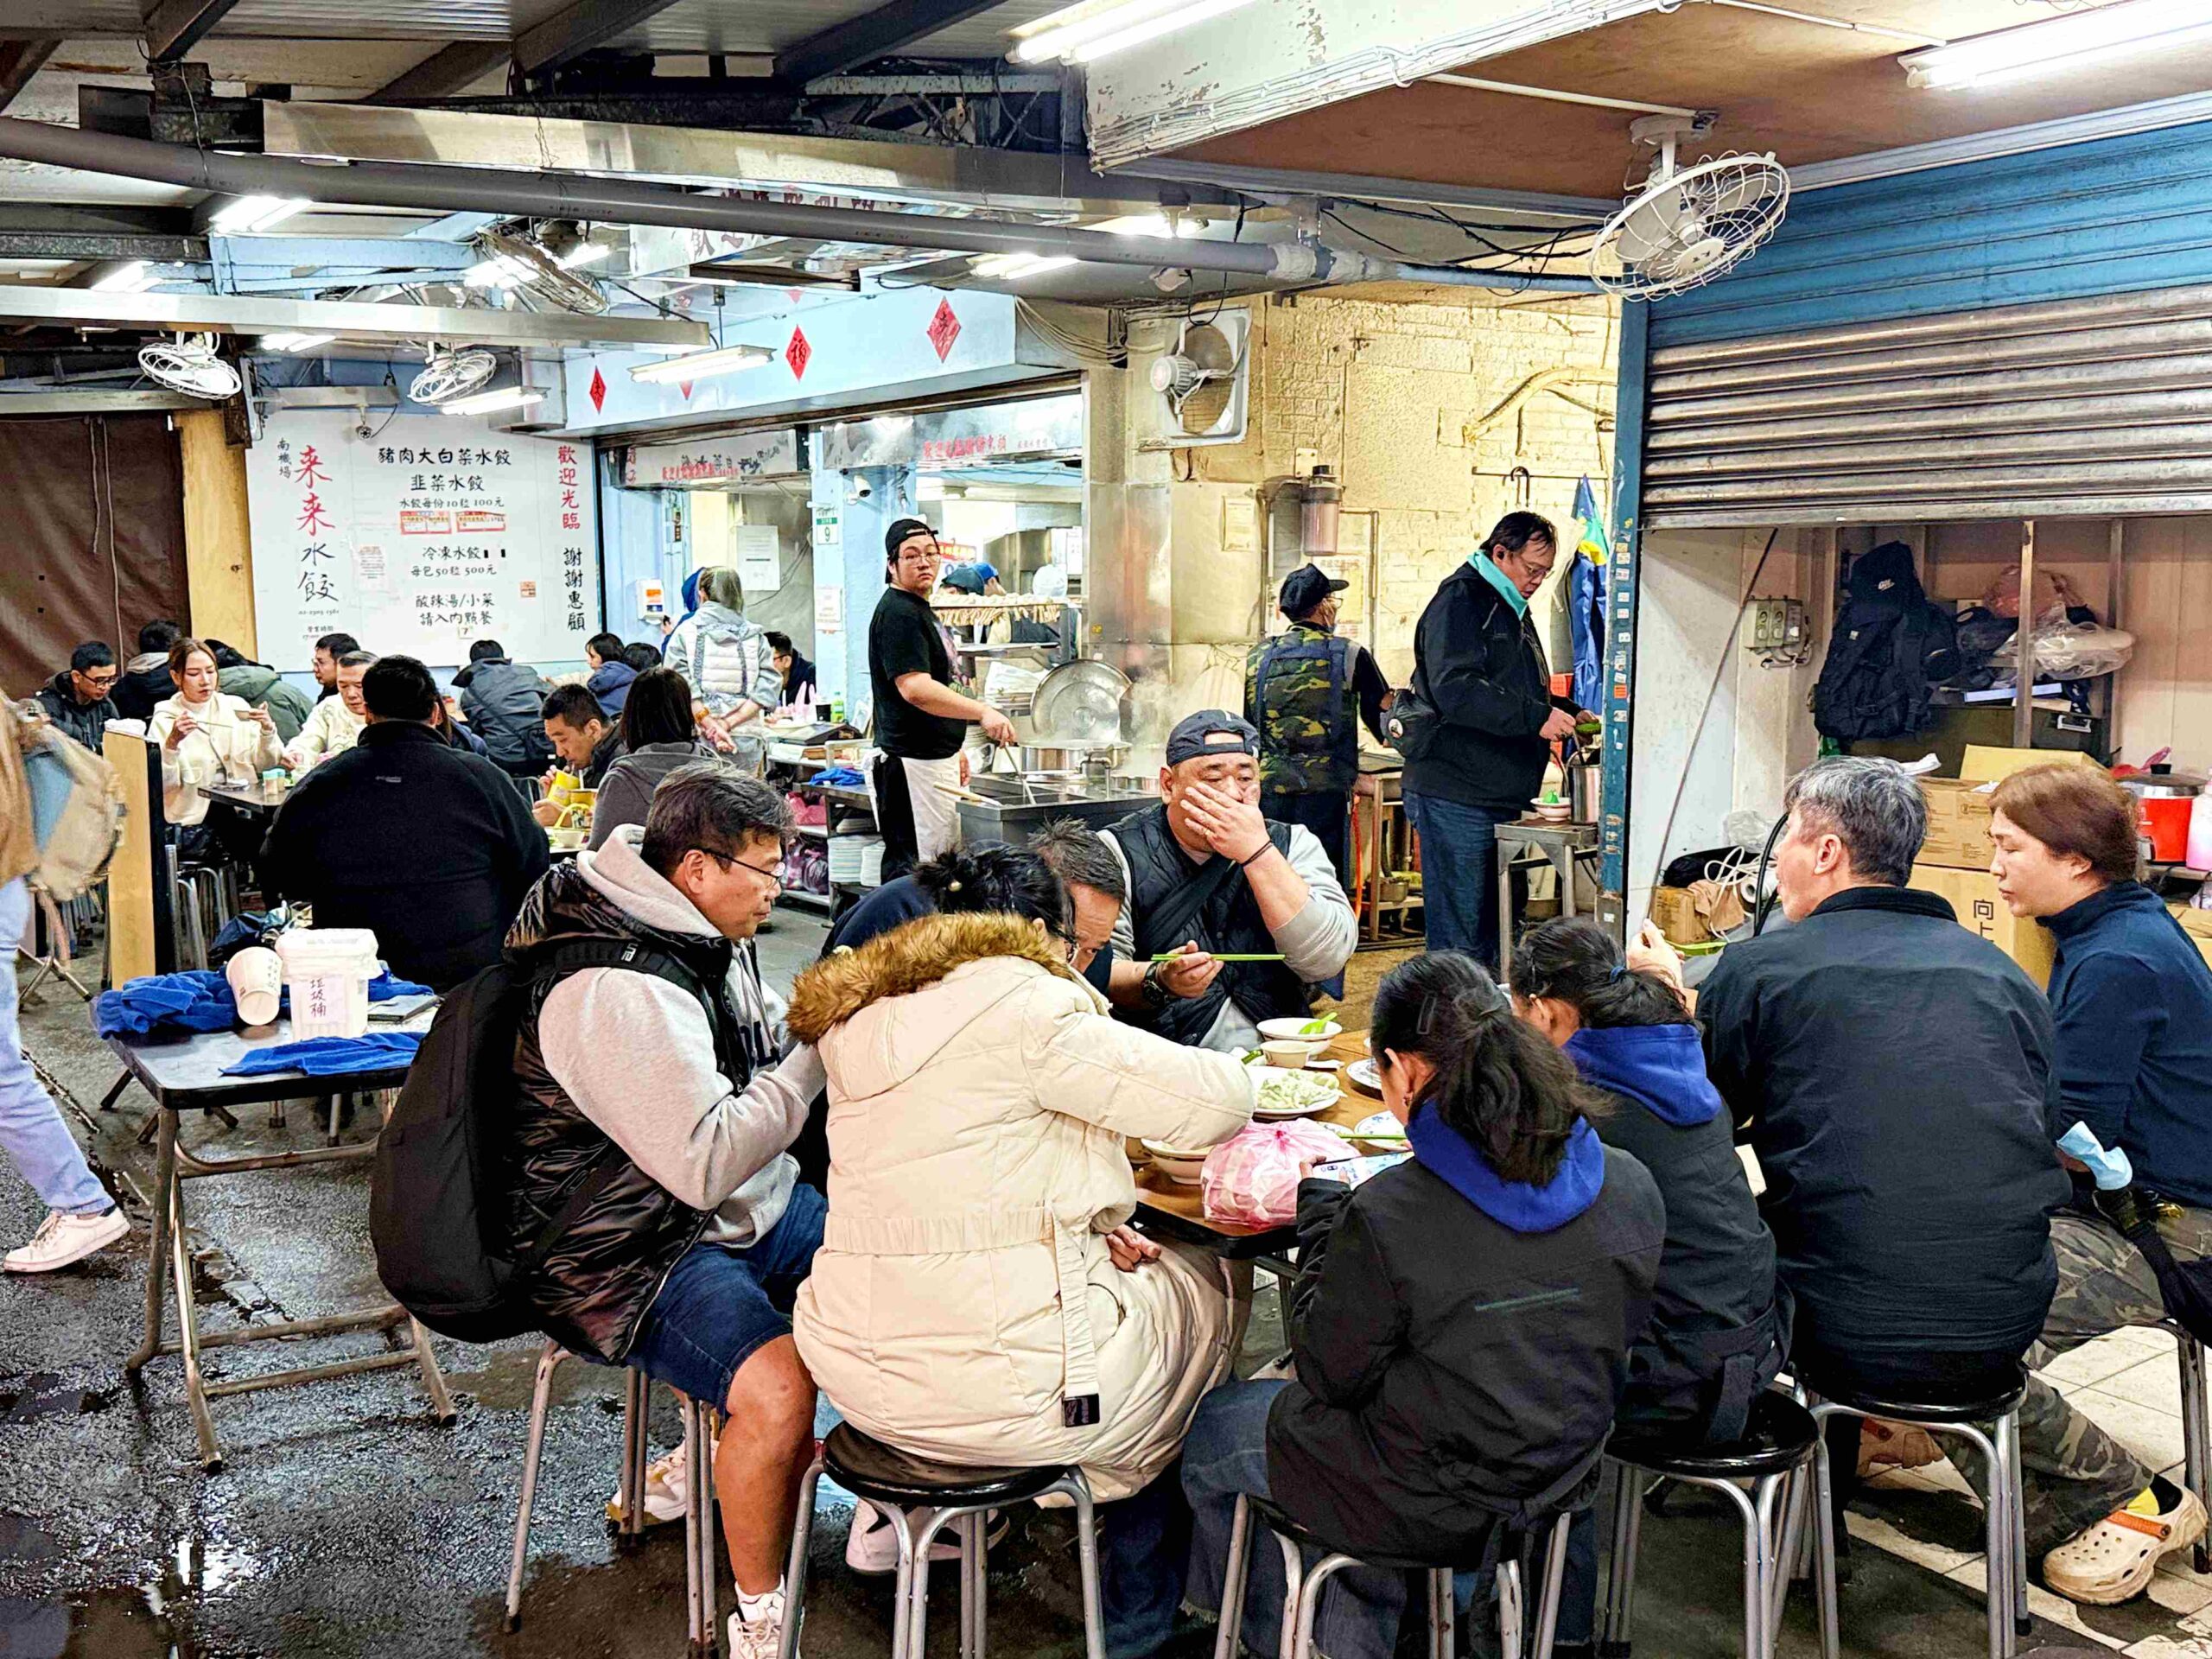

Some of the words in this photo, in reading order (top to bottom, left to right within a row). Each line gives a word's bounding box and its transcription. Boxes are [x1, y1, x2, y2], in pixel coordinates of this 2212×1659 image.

[277, 437, 292, 479] 南機場
[378, 448, 512, 466] 豬肉大白菜水餃
[410, 474, 485, 492] 韭菜水餃
[557, 445, 581, 530] 歡迎光臨
[824, 525, 830, 543] 9
[423, 546, 481, 560] 冷凍水餃
[464, 563, 497, 576] 500元
[563, 547, 586, 631] 謝謝惠顧
[416, 593, 495, 607] 酸辣湯/小菜
